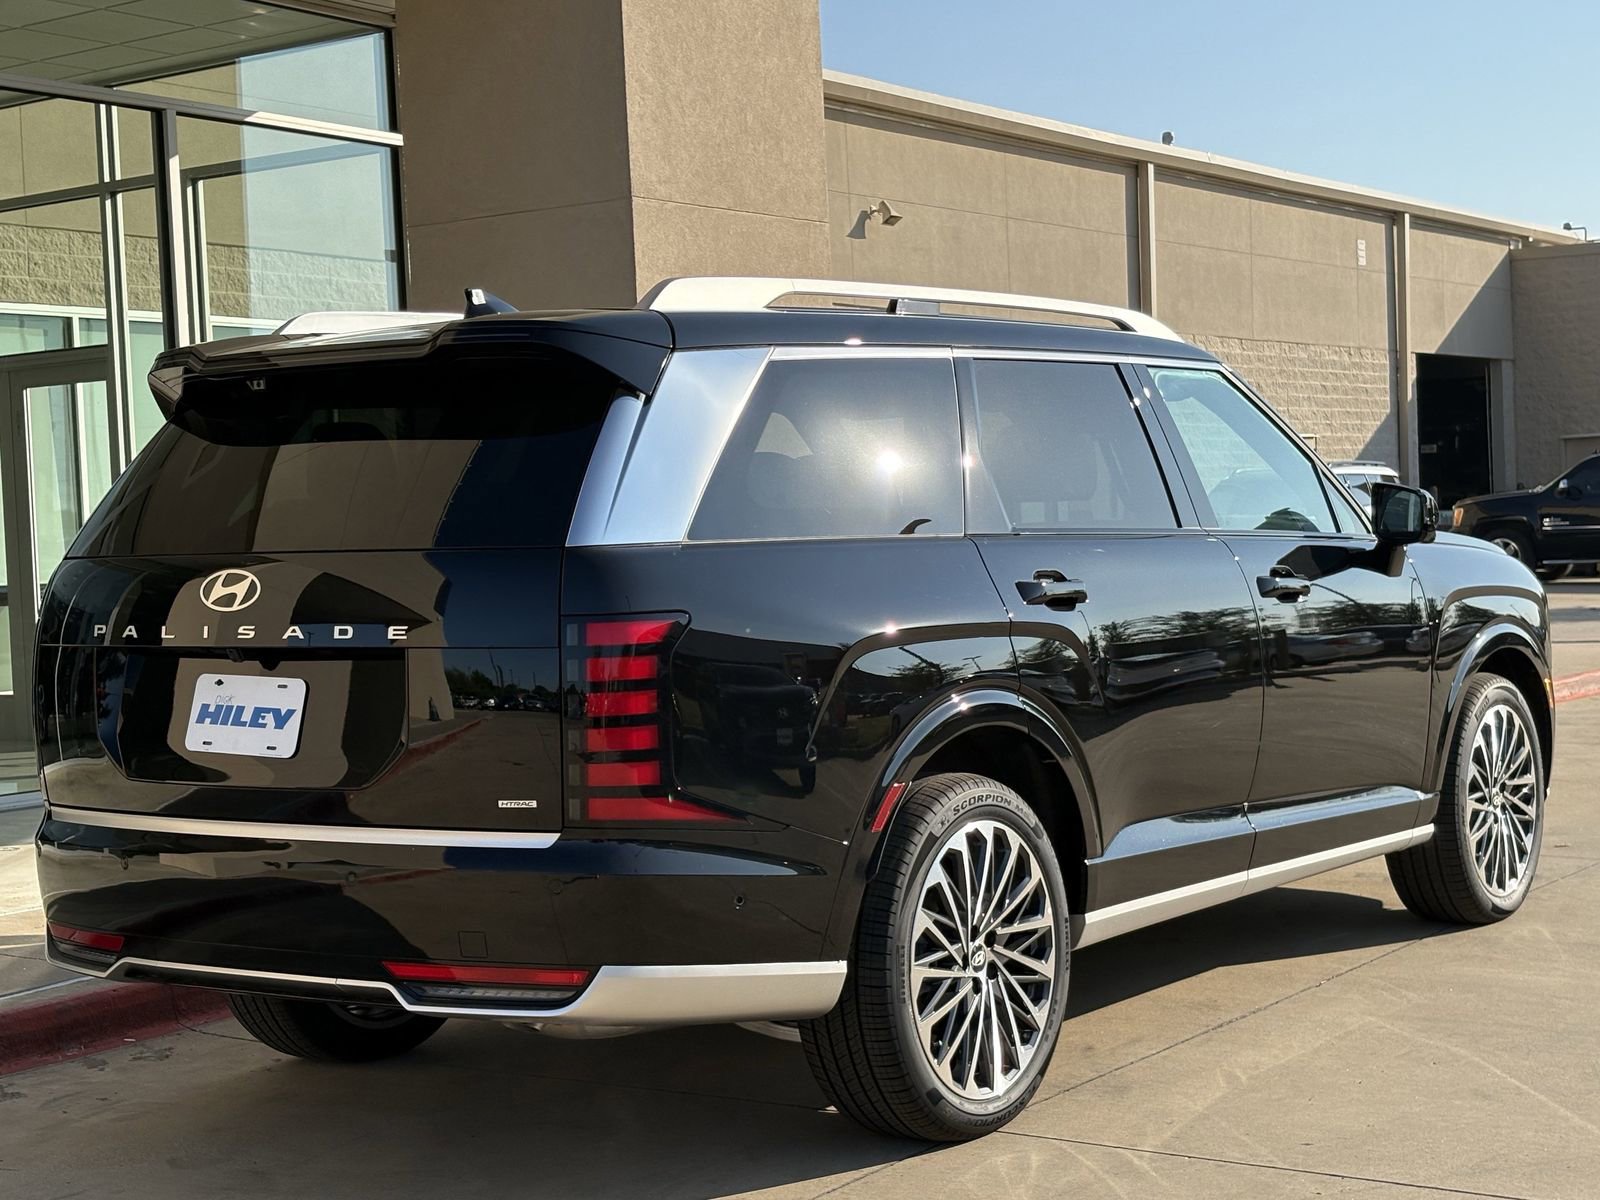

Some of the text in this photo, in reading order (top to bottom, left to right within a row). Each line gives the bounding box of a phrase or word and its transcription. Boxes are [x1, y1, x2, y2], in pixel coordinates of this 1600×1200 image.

[93, 625, 409, 640] PALISADE
[195, 703, 297, 730] HILEY
[952, 794, 1012, 816] SCORPION
